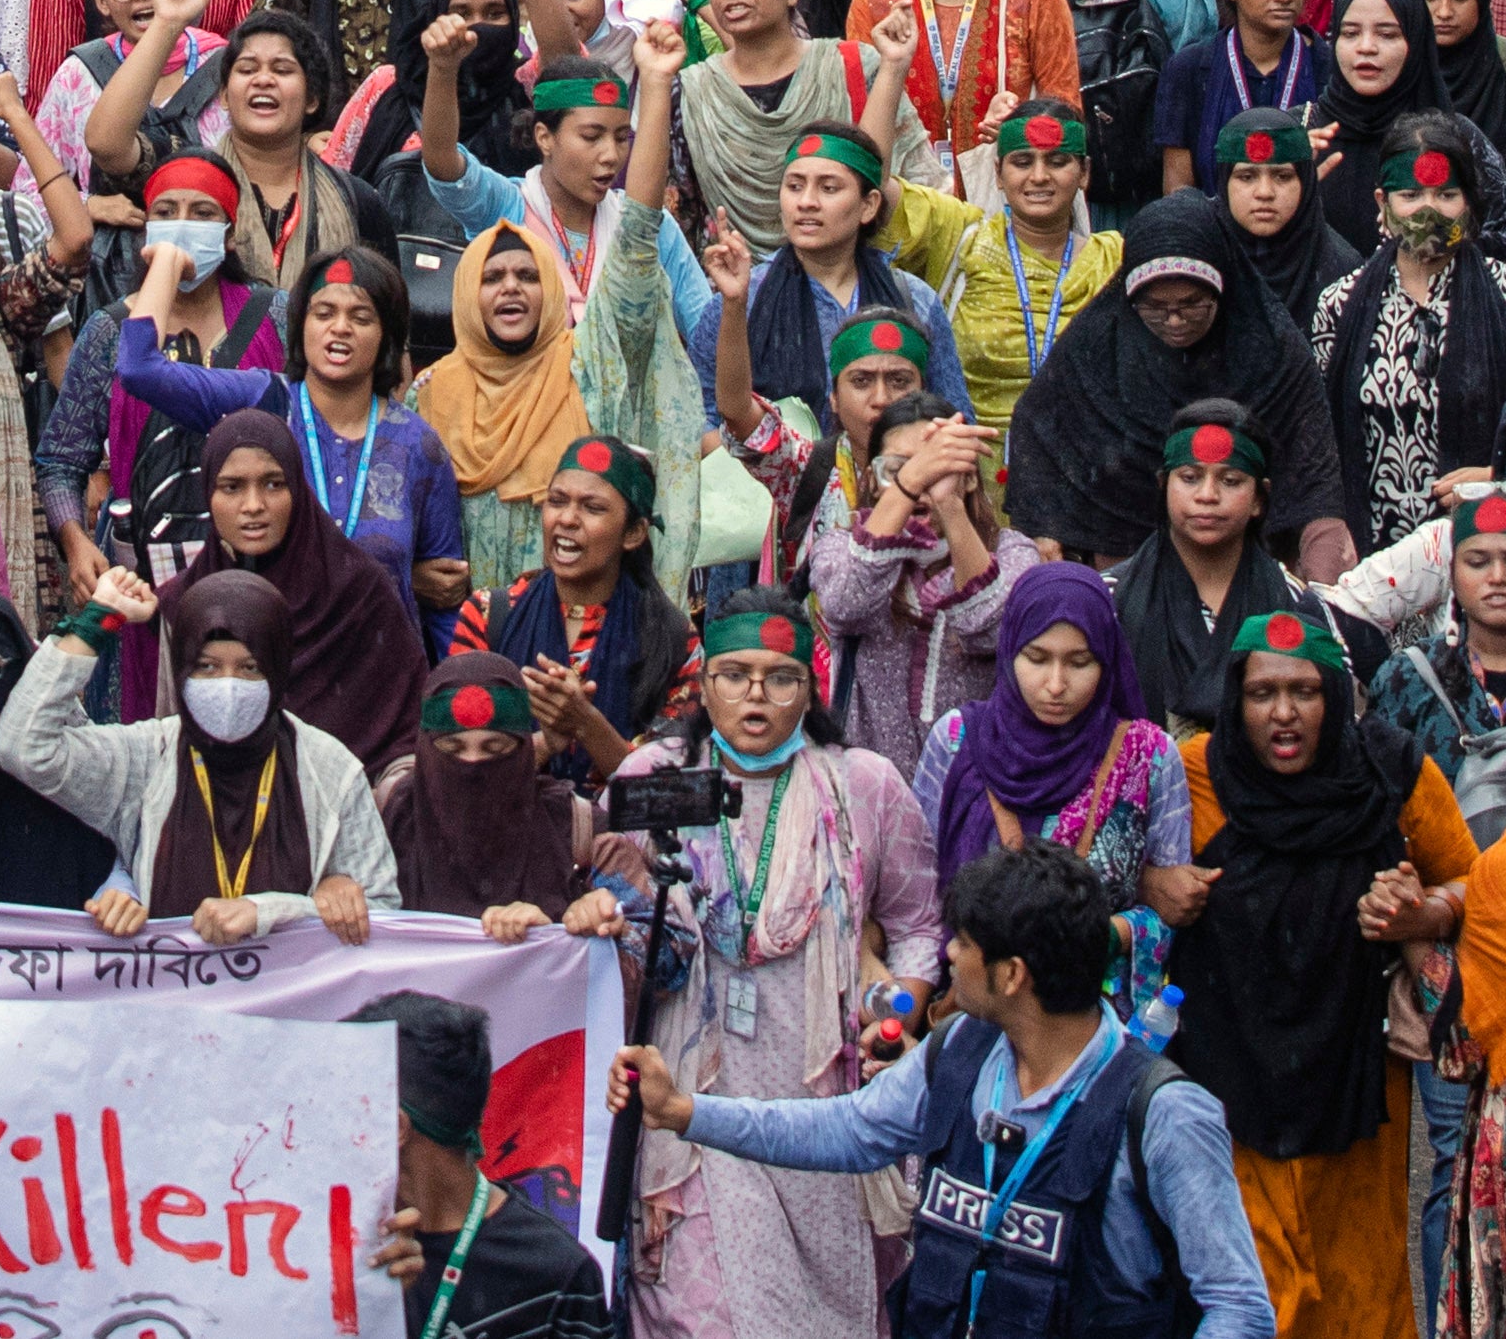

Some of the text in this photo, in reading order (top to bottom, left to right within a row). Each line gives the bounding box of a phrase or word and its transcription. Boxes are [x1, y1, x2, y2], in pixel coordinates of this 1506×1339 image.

[930, 32, 941, 55] IDEAL
[767, 808, 779, 823] OF
[759, 822, 777, 858] HEALTH
[749, 859, 770, 902] SCIENCES
[86, 933, 270, 991] দাবিতে
